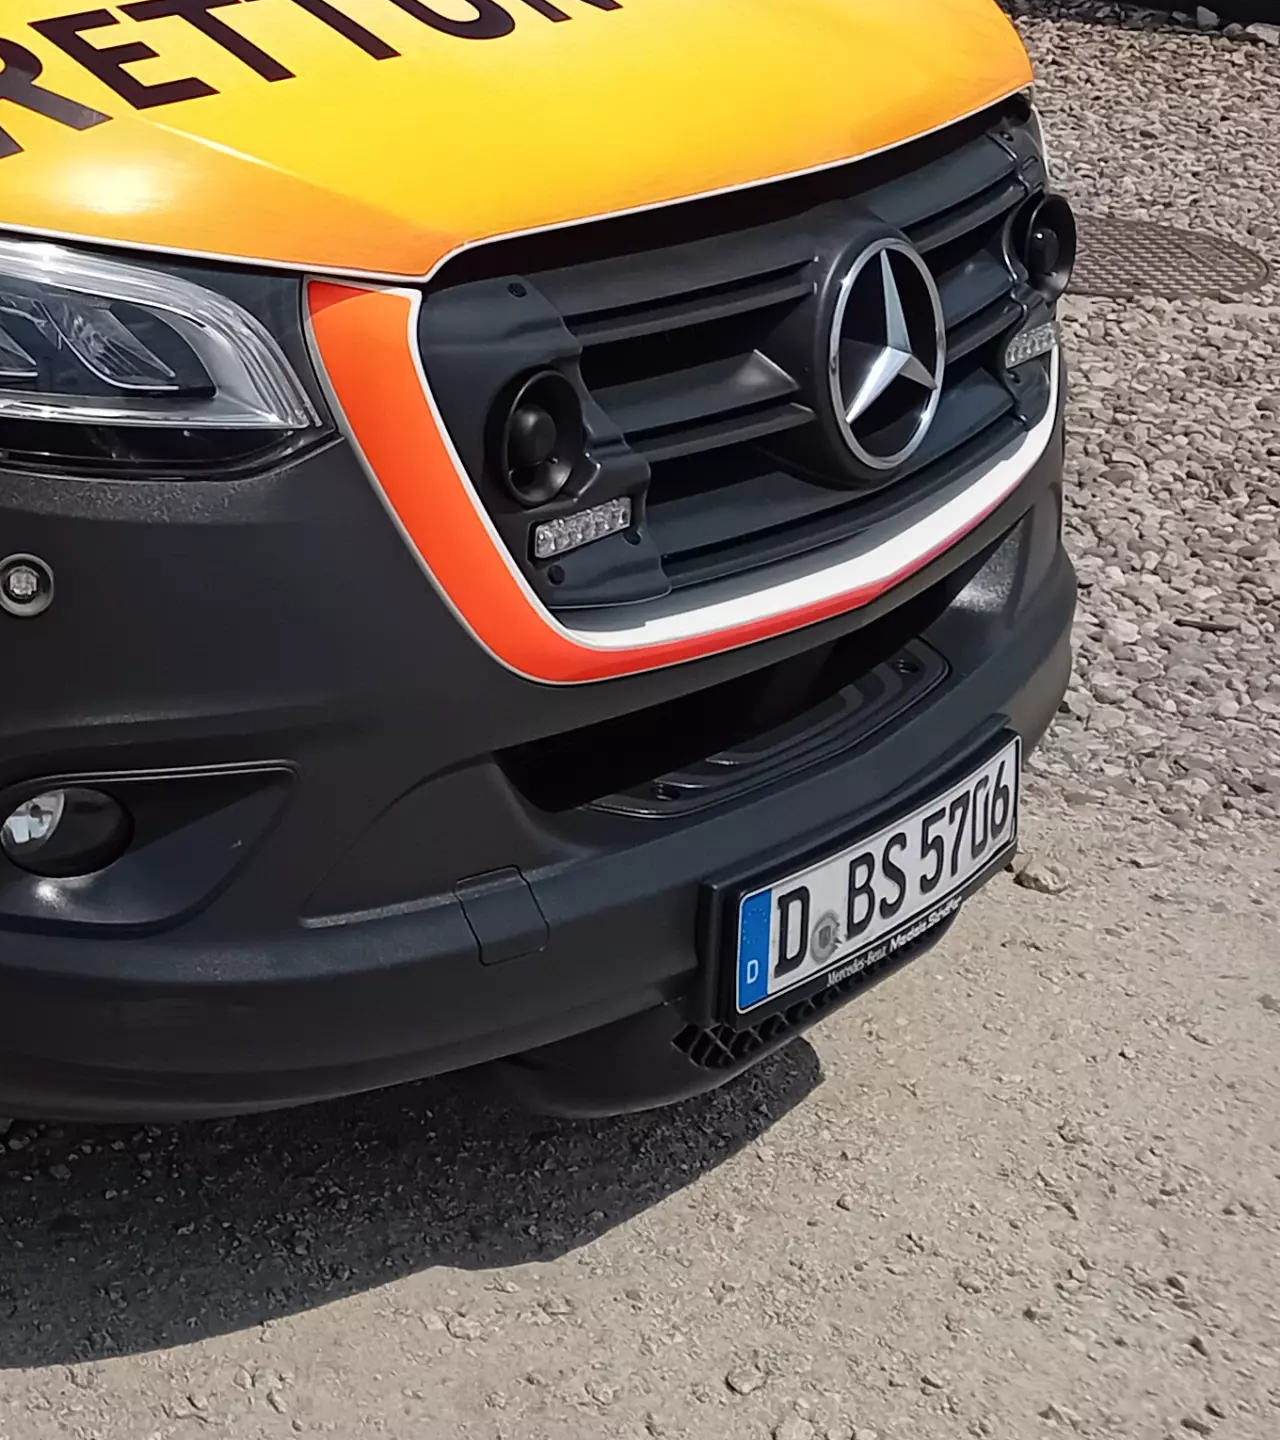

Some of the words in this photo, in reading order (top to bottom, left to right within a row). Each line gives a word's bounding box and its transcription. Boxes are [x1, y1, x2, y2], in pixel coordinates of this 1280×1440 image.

[773, 885, 811, 980] D
[847, 832, 908, 939] BS
[920, 760, 1010, 895] 5706
[746, 959, 759, 984] D
